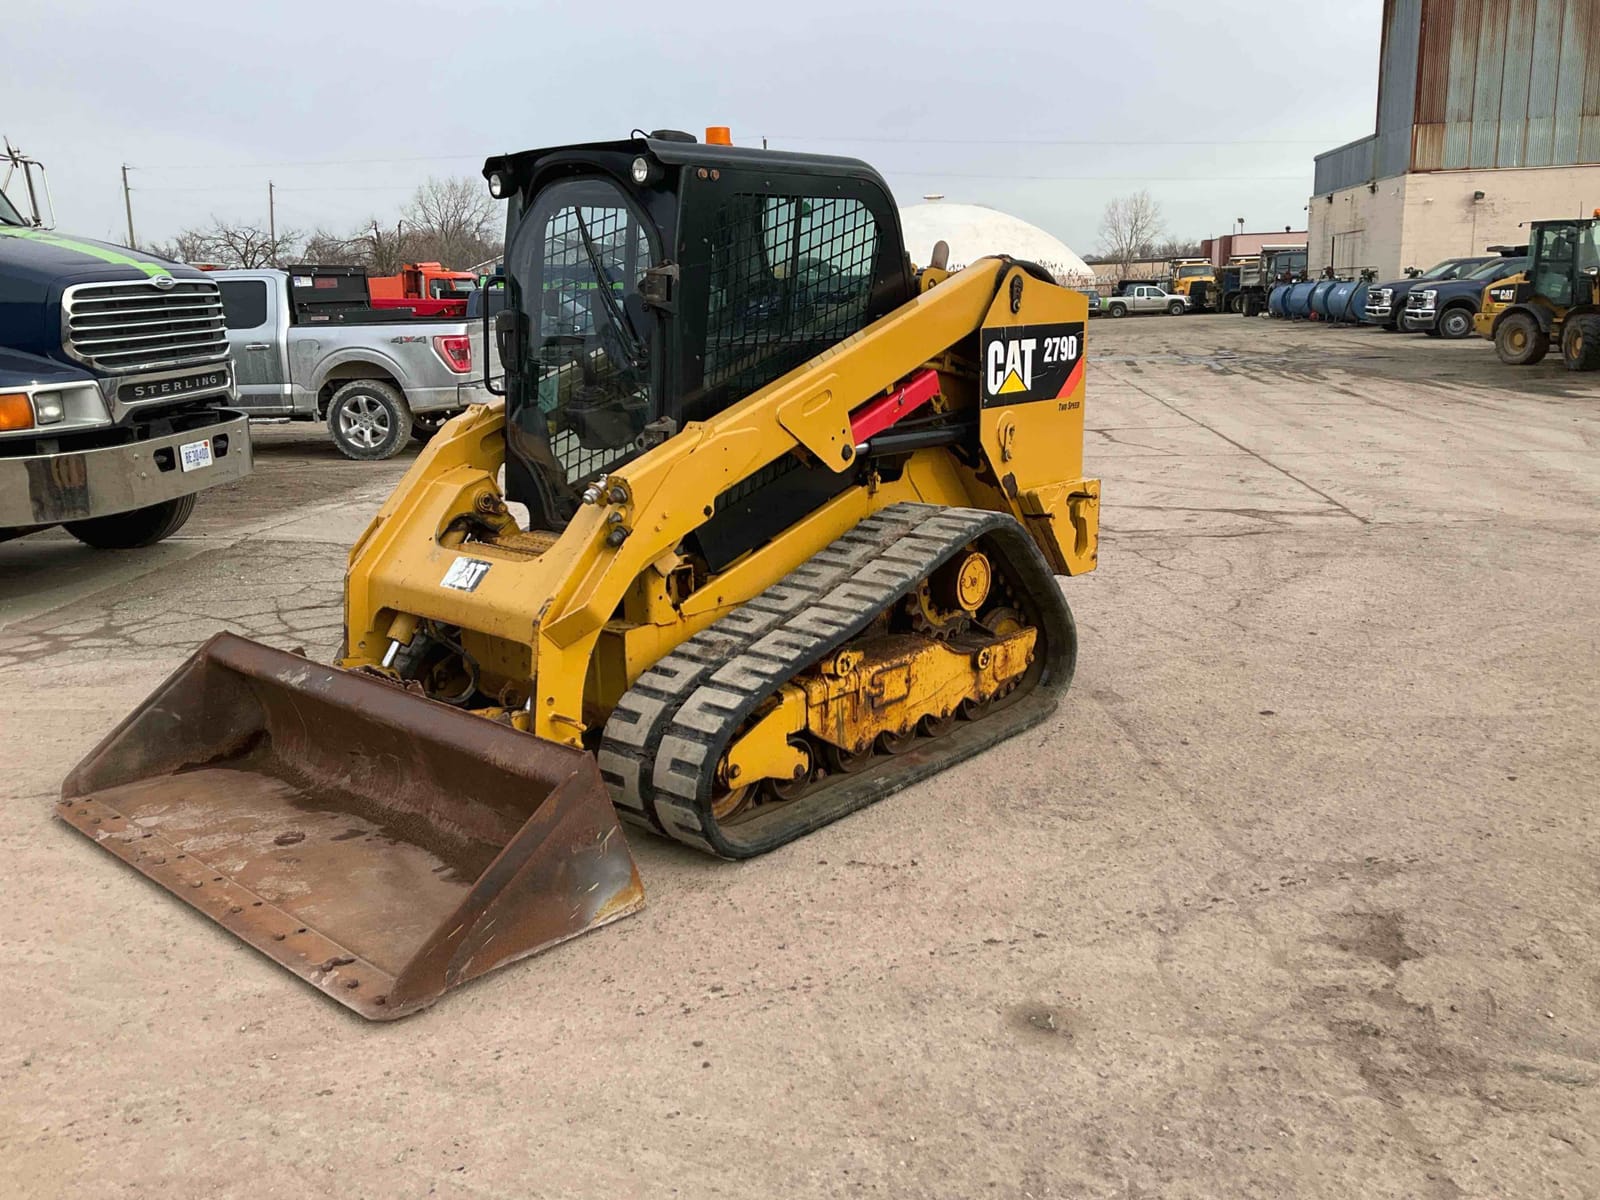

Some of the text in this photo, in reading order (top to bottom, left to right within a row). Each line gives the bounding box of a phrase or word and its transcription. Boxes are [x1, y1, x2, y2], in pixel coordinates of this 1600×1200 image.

[1500, 289, 1514, 300] CAT
[987, 335, 1078, 395] CAT 279D
[134, 375, 217, 397] STERLING
